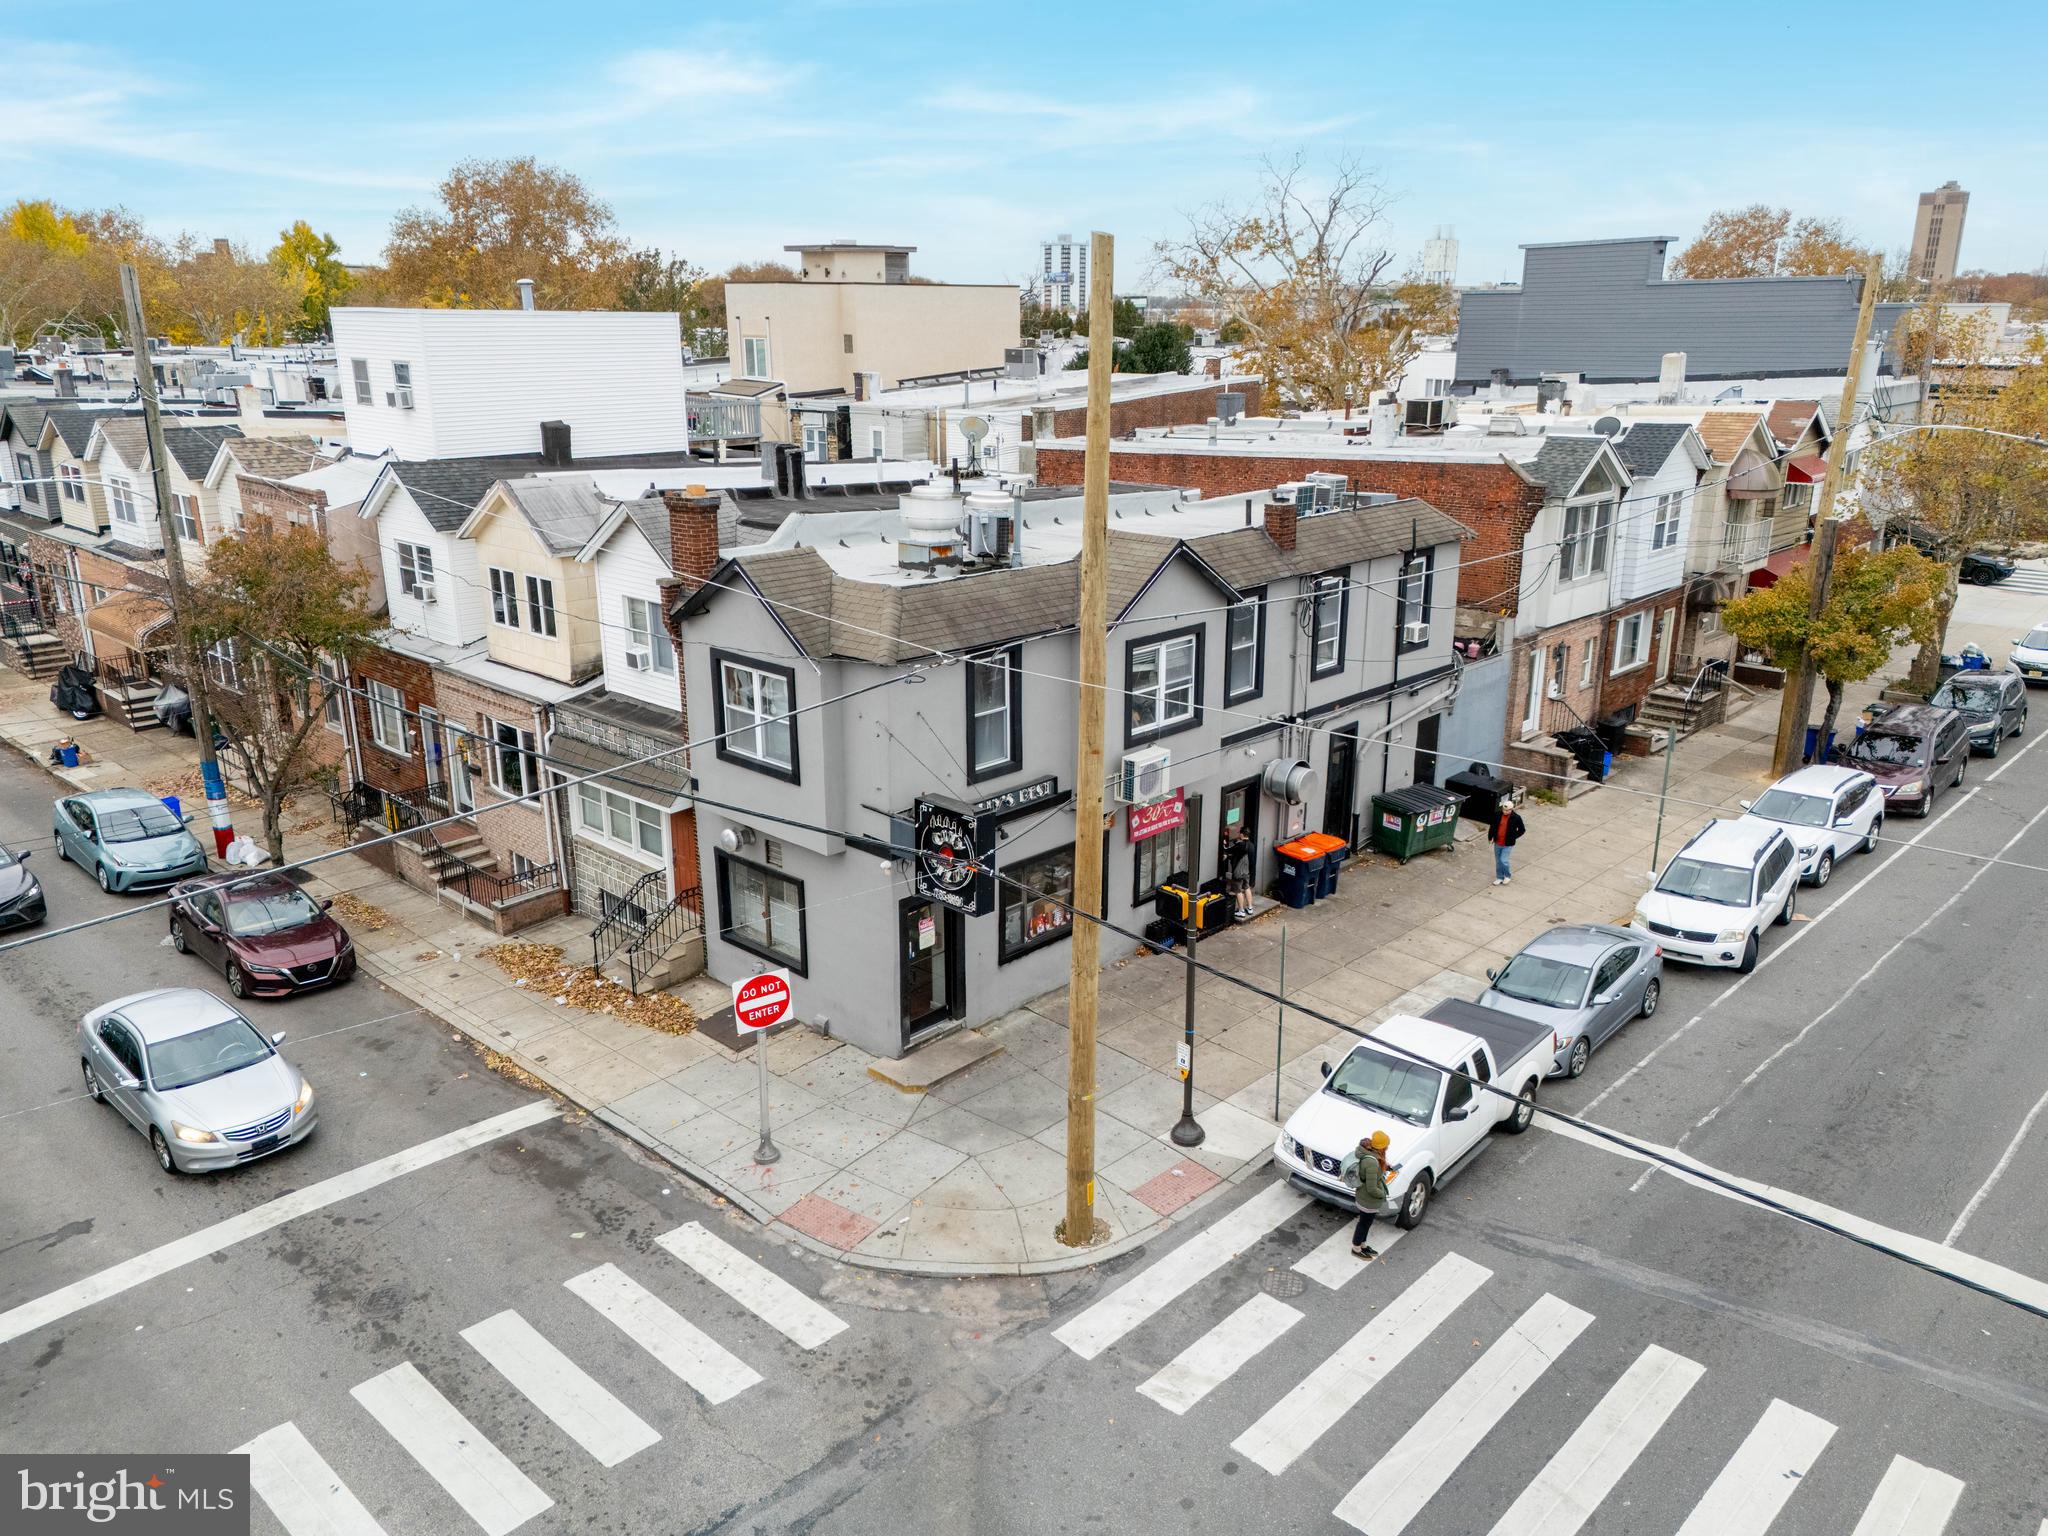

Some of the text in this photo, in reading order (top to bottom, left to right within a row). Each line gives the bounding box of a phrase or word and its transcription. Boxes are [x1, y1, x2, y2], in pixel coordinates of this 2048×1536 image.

[1020, 781, 1052, 802] BEST
[742, 981, 781, 999] DO NOT
[749, 1004, 780, 1021] ENTER
